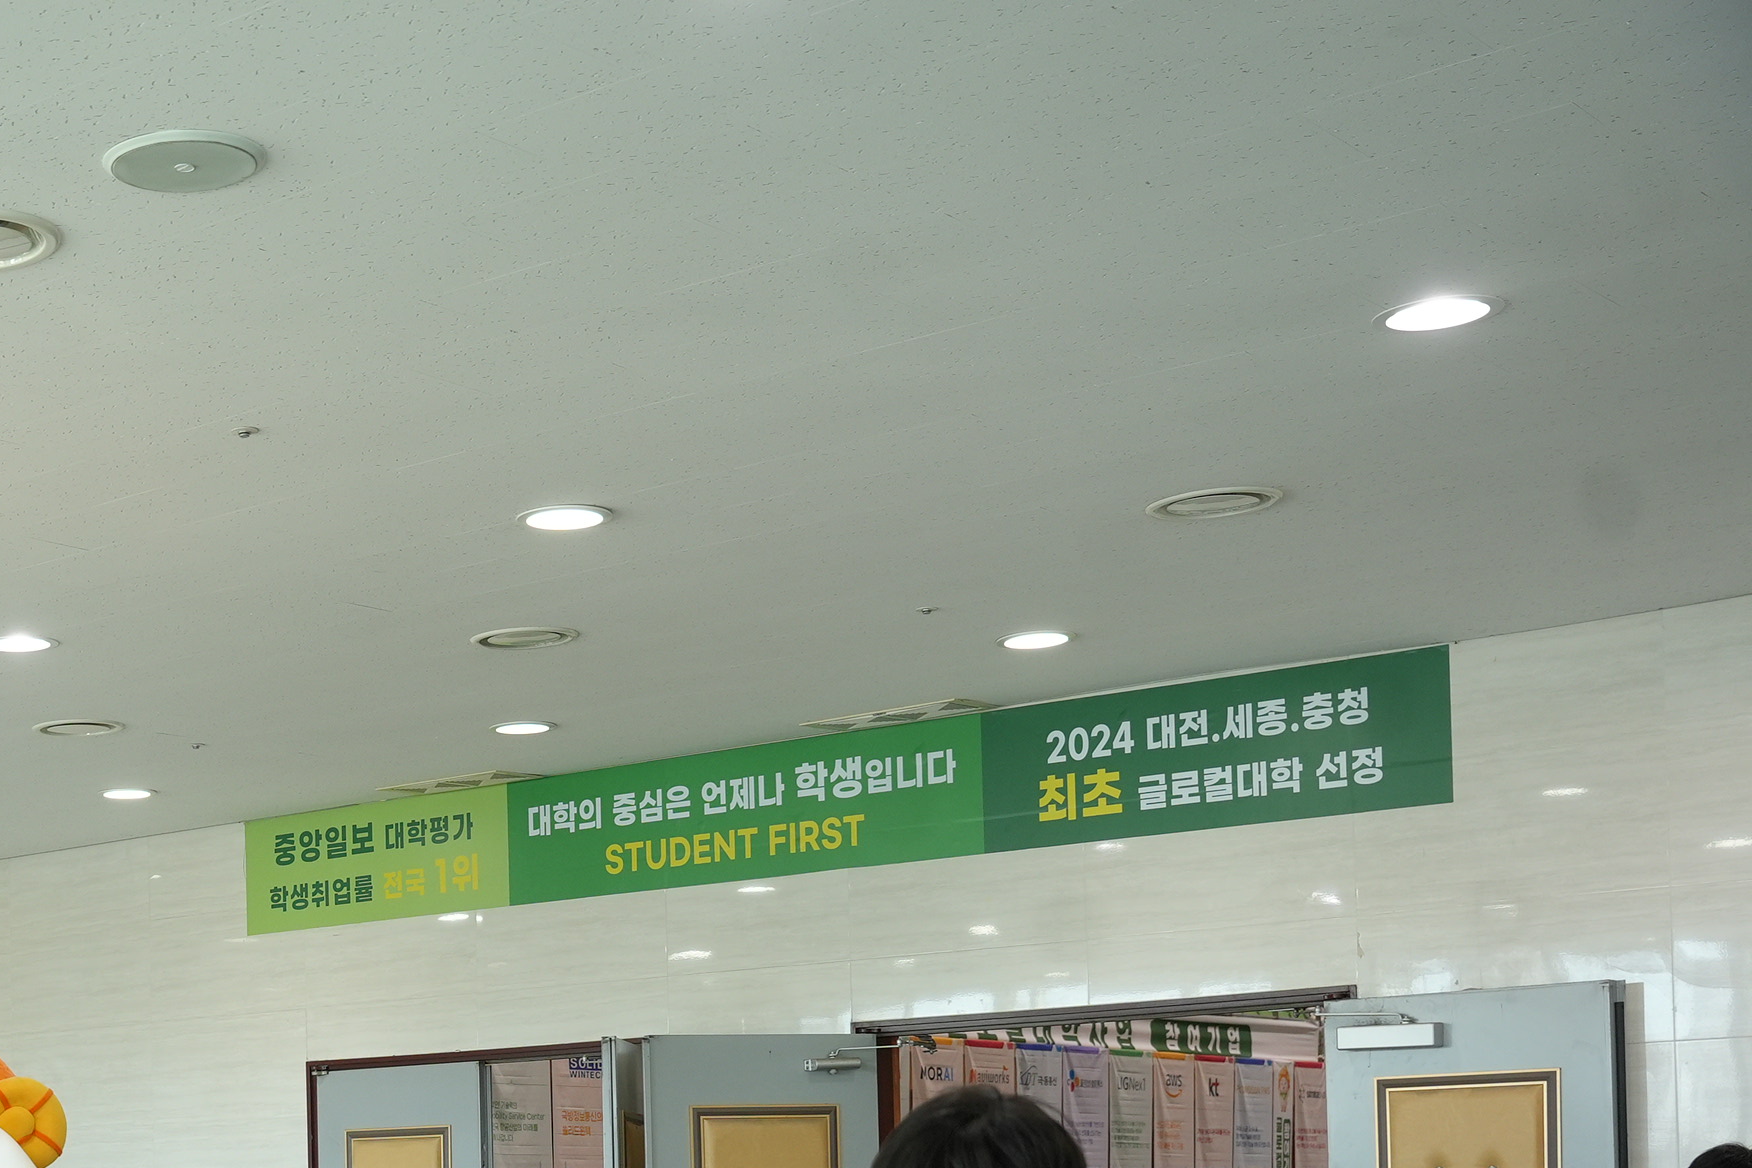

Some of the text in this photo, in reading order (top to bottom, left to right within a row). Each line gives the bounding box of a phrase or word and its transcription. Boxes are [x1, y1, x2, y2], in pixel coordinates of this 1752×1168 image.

[1045, 686, 1370, 764] 2024 대전.세종.충청
[527, 748, 957, 837] 대학의 중심은 언제나 학생입니다
[1038, 746, 1384, 822] 최초 글로컬대학 선정
[273, 812, 474, 866] 중앙일보 대학평가
[604, 814, 865, 874] STUDENT FIRST
[269, 853, 480, 912] 학생취업률 전국 1위
[1164, 1021, 1241, 1055] 참여기업
[919, 1066, 954, 1082] MORAI
[1165, 1073, 1183, 1087] aws
[1208, 1077, 1220, 1097] kt
